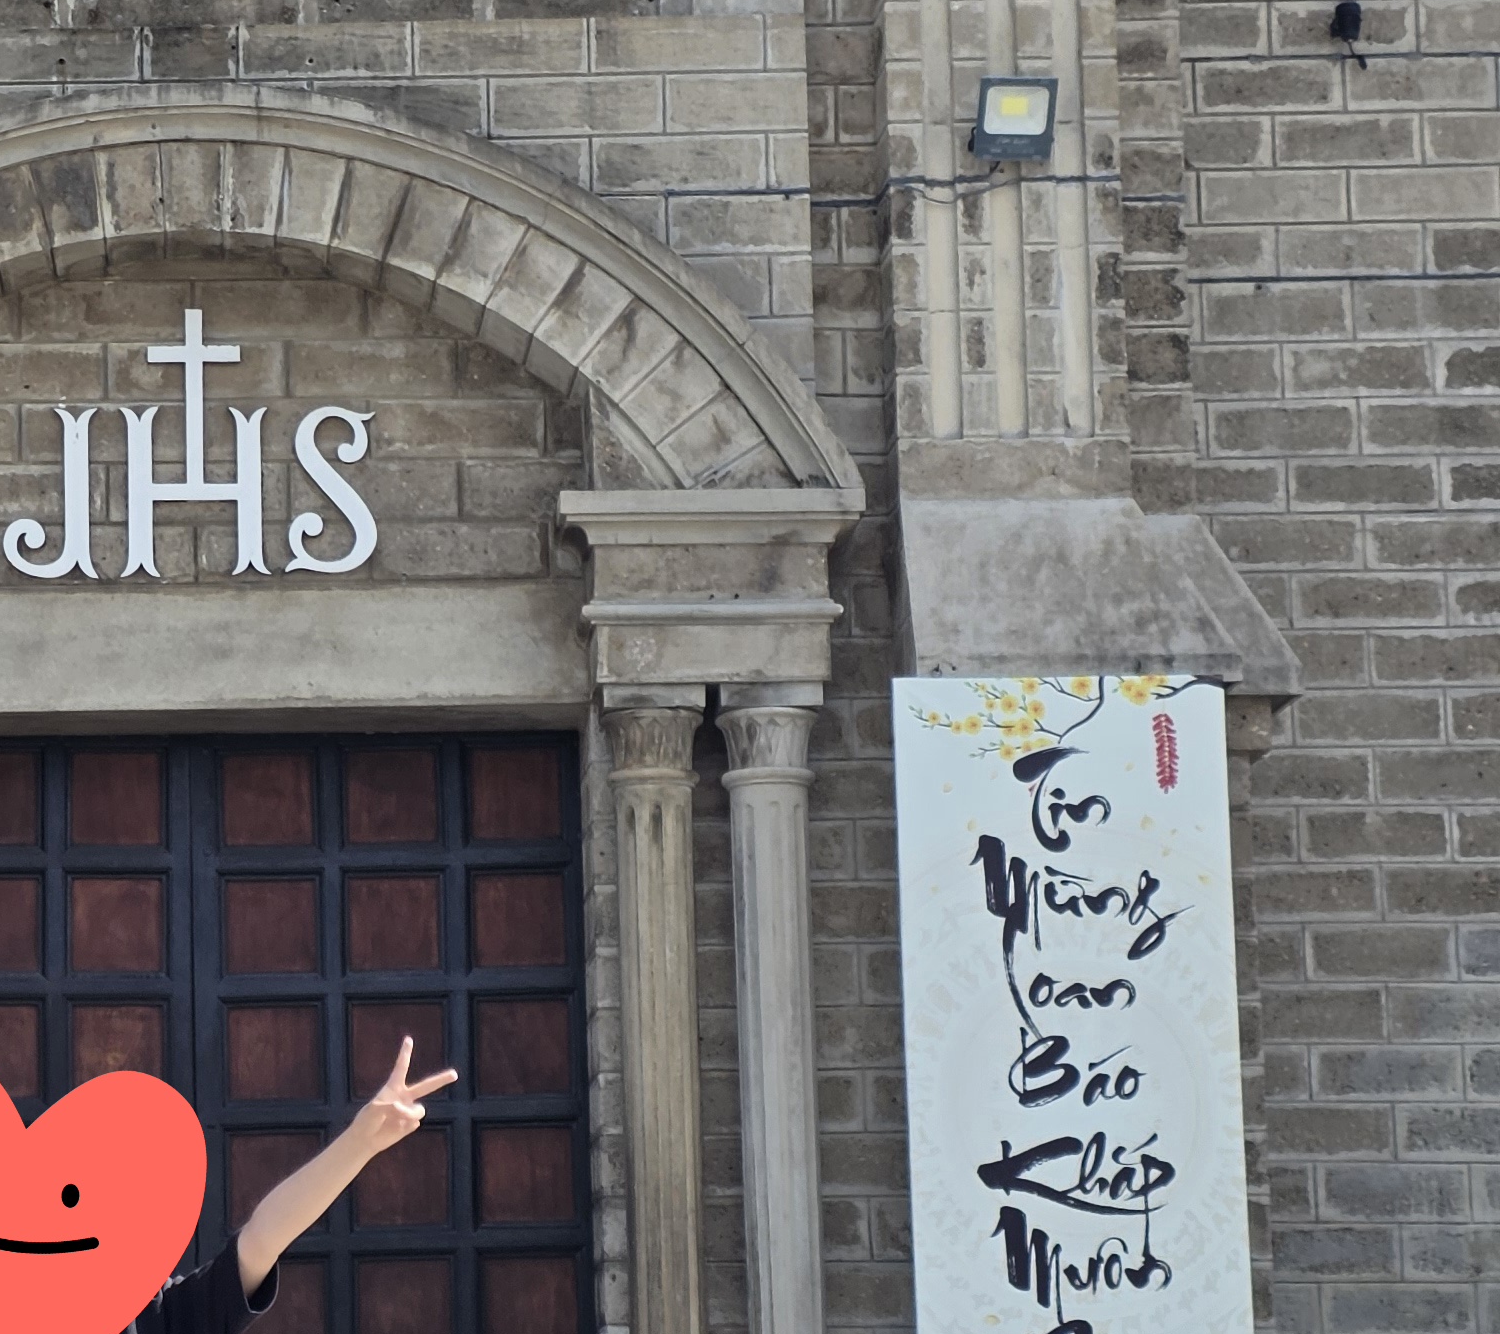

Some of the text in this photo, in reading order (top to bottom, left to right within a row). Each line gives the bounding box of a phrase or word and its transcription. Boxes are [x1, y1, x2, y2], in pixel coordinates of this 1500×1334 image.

[1013, 746, 1112, 853] Tin
[969, 834, 1195, 960] Mừng
[1008, 1027, 1147, 1108] Báo
[977, 1131, 1177, 1245] Khắp
[991, 1205, 1173, 1312] Muôn
